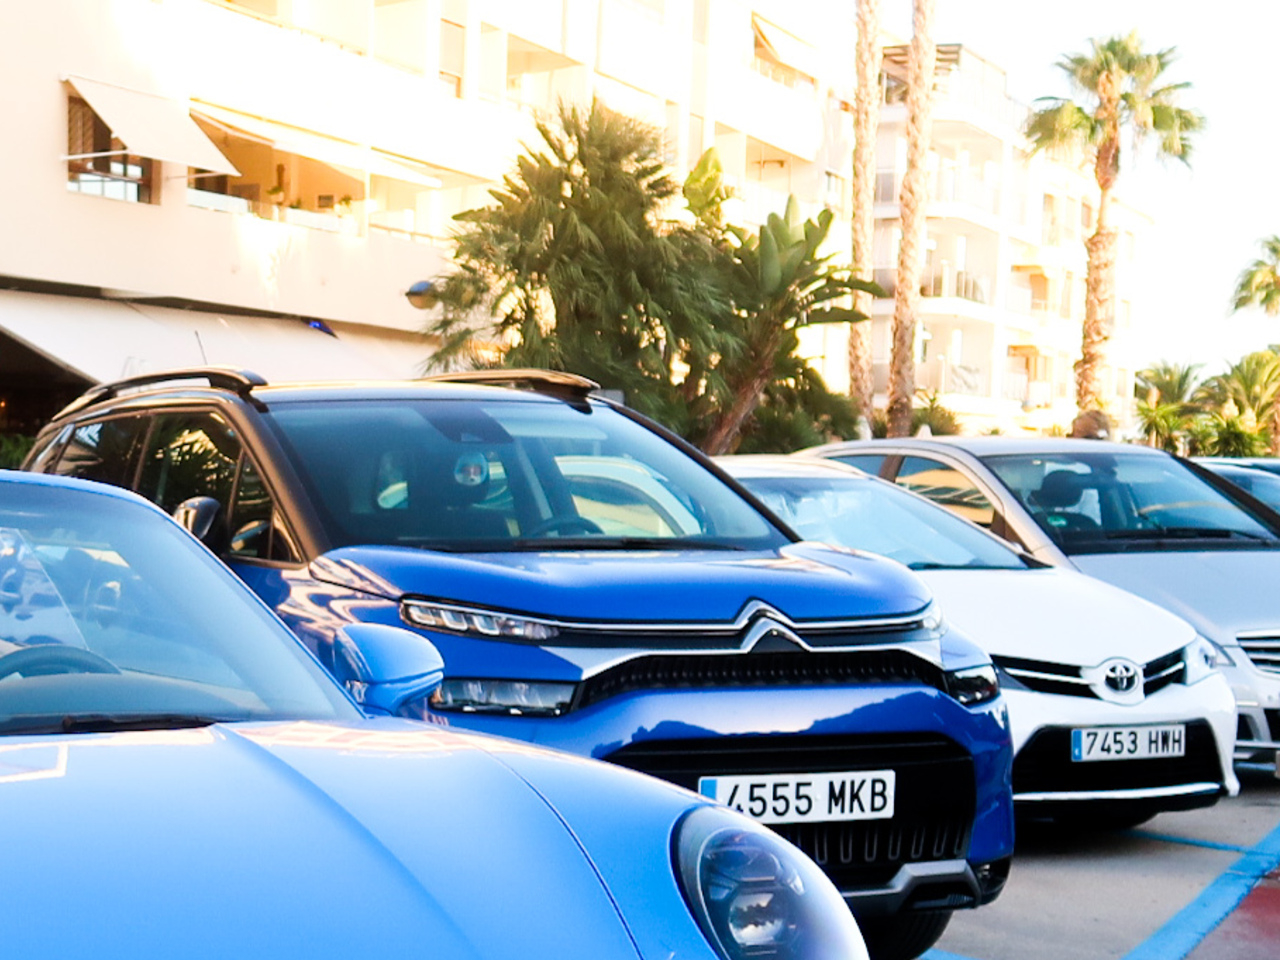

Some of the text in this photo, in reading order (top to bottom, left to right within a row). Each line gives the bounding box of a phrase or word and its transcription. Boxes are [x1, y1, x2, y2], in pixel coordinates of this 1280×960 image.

[1086, 730, 1183, 755] 7453 HWH
[727, 778, 888, 817] 4555 MKB
